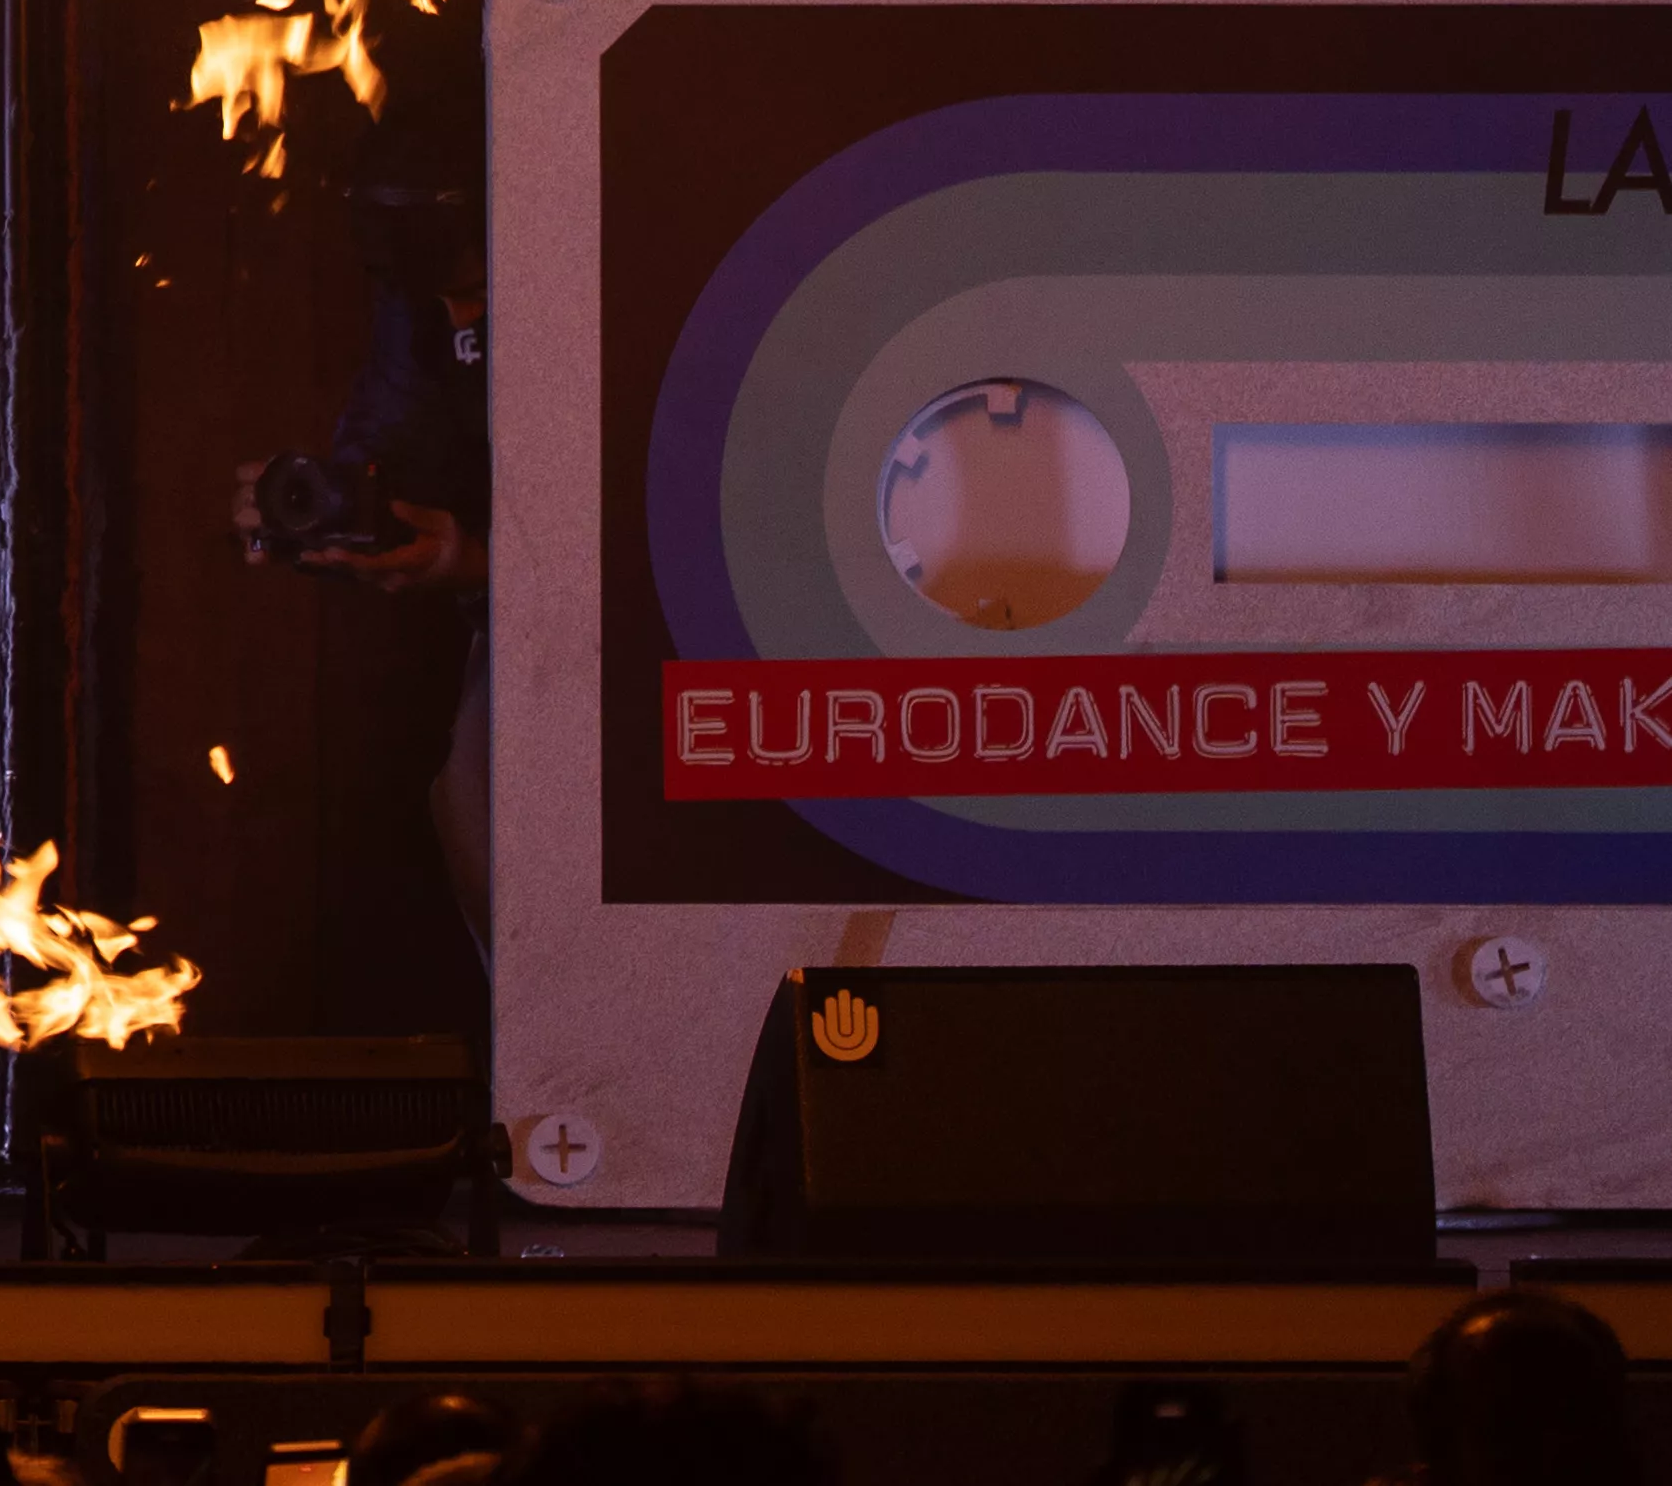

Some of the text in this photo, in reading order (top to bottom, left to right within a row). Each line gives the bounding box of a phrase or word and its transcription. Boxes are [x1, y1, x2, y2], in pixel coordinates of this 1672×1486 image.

[1544, 104, 1672, 215] LA
[677, 681, 1330, 765] EURODANCE
[1369, 682, 1427, 756] Y
